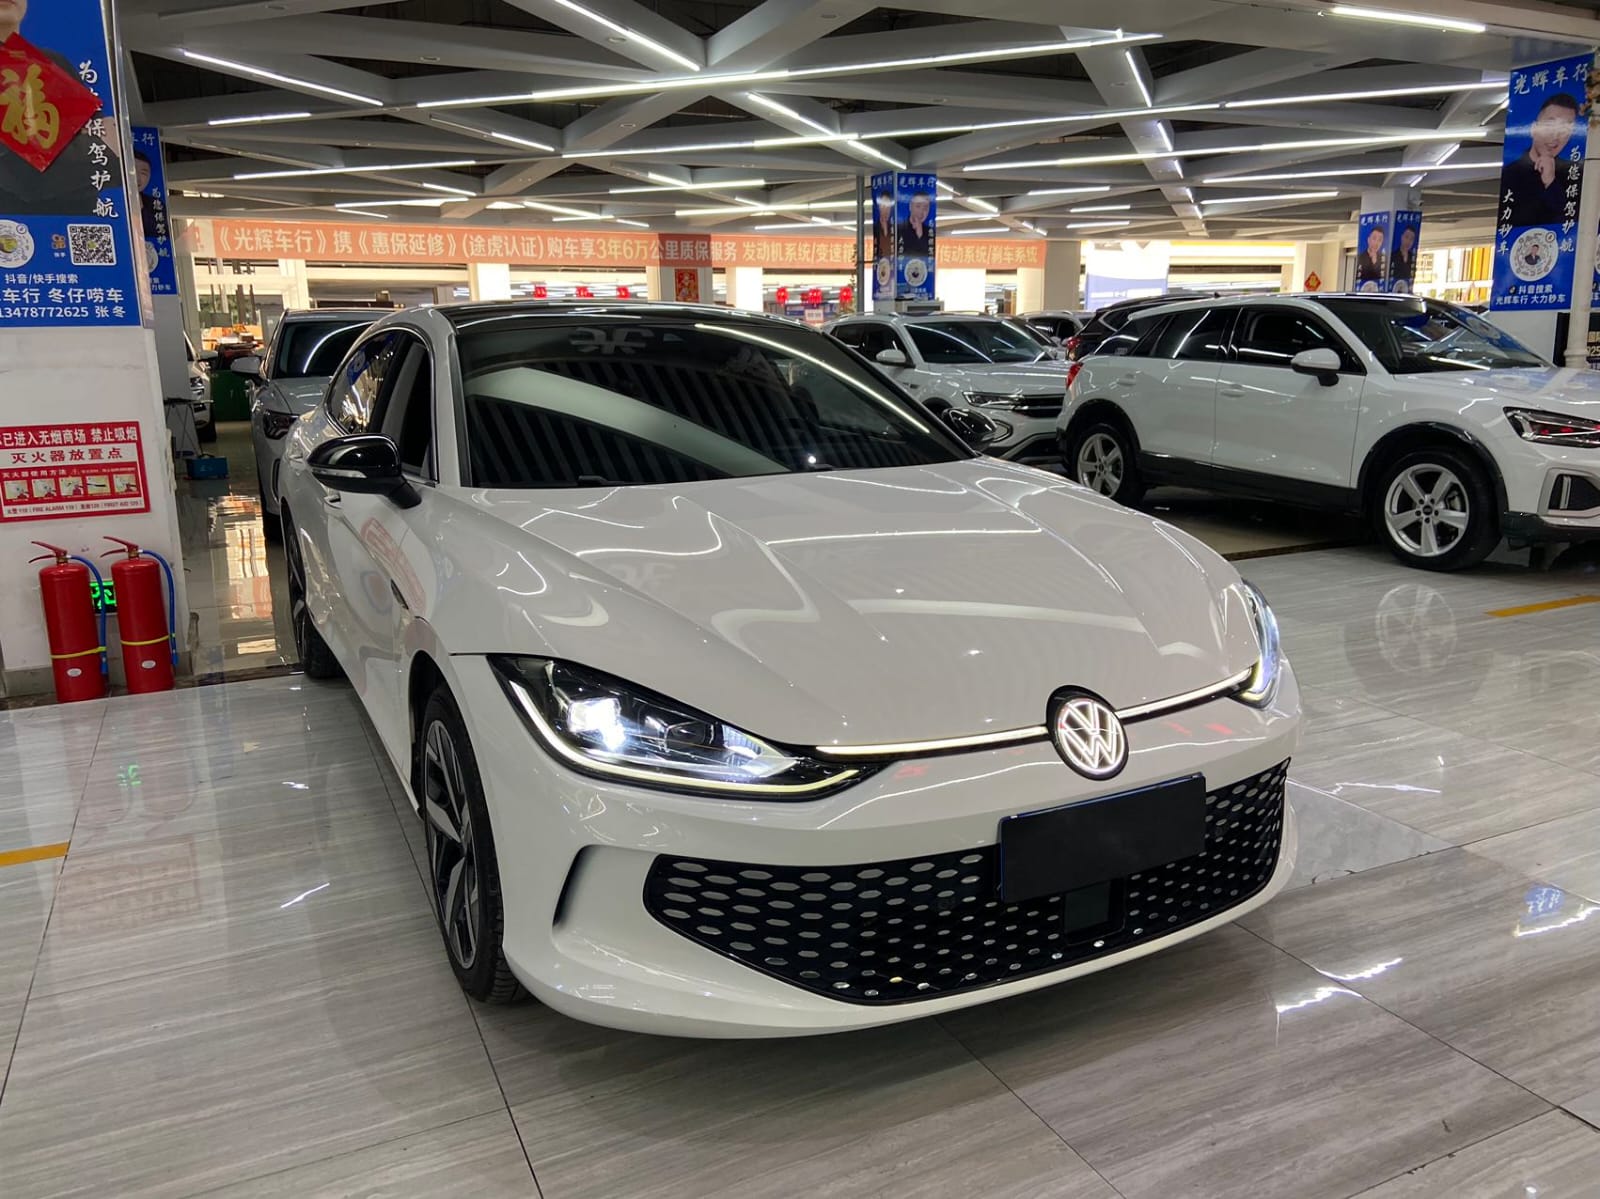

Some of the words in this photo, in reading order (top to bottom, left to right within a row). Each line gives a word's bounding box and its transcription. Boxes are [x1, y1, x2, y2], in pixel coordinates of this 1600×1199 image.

[1514, 63, 1588, 94] 光辉车行
[0, 63, 60, 149] 福
[79, 60, 119, 218] 为保驾护航
[1560, 145, 1581, 252] 为您保驾护航
[5, 273, 79, 285] 抖音/快手搜索
[0, 288, 41, 304] 车行
[48, 287, 124, 304] 冬仔唠车
[0, 306, 89, 318] 13478772625
[0, 428, 86, 447] 已进入无烟商场
[90, 426, 138, 443] 禁止吸烟
[10, 447, 122, 464] 灭火器放置点
[1058, 698, 1126, 773] VW
